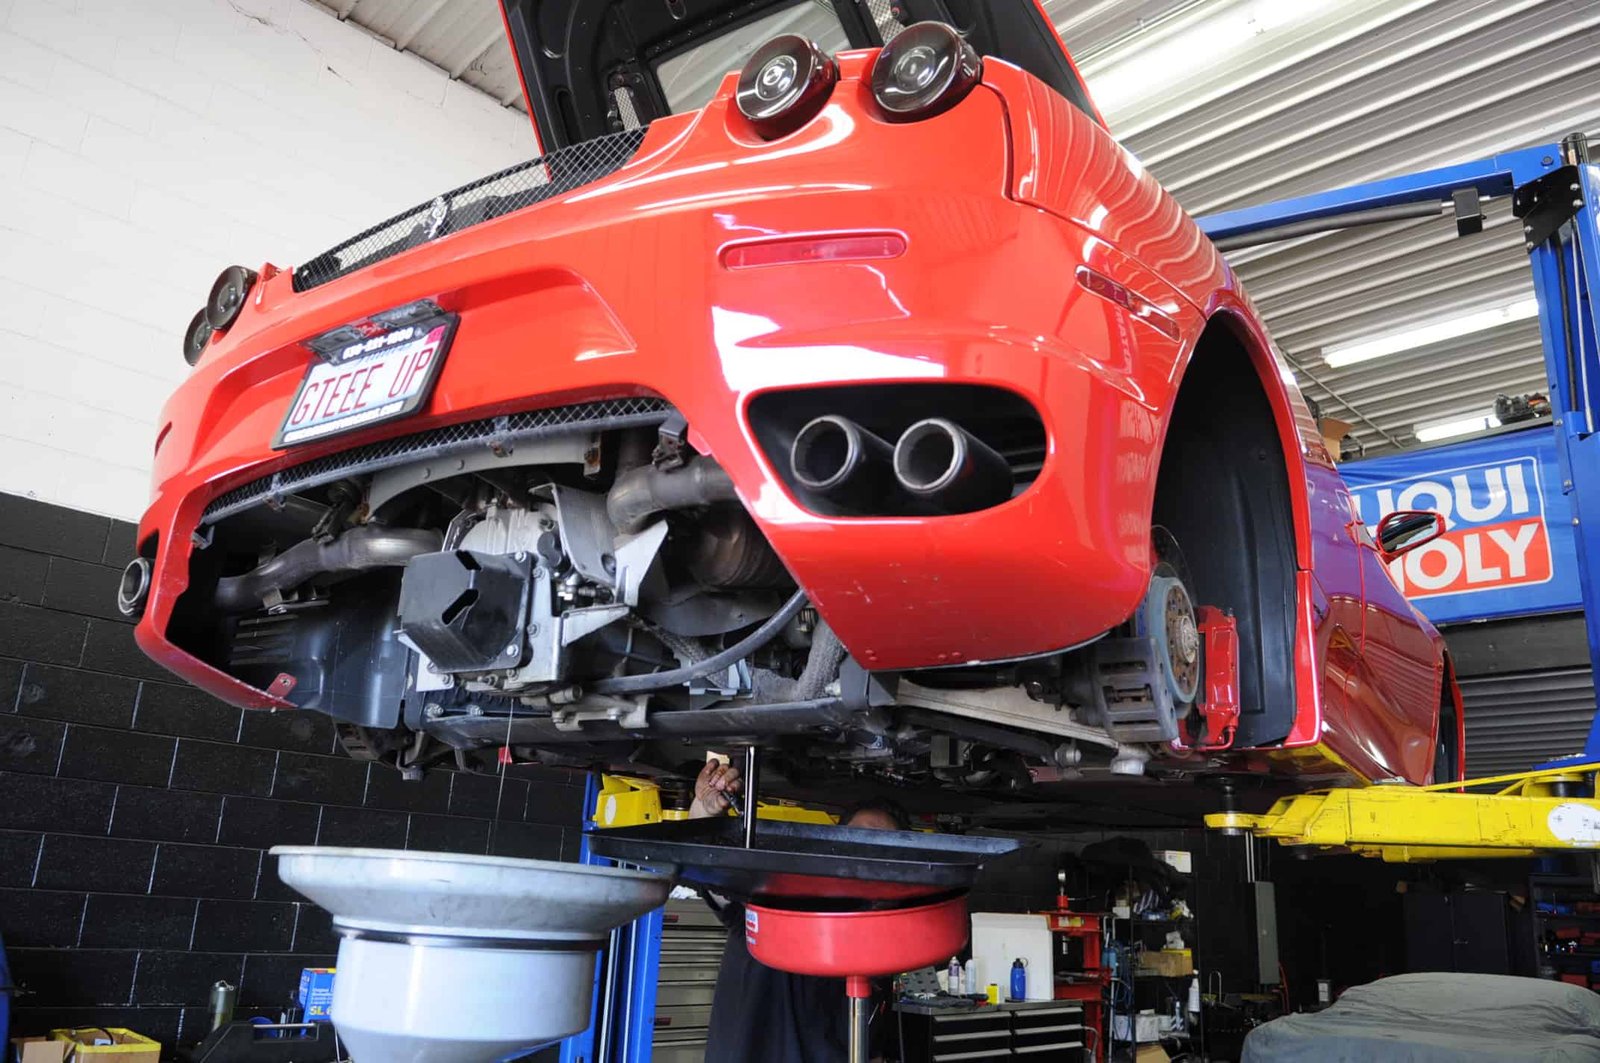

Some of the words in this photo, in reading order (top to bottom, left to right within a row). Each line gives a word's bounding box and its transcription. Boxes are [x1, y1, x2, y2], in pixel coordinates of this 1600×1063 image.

[291, 362, 384, 425] GTEEE
[388, 347, 433, 398] UP
[1388, 523, 1539, 593] OLY
